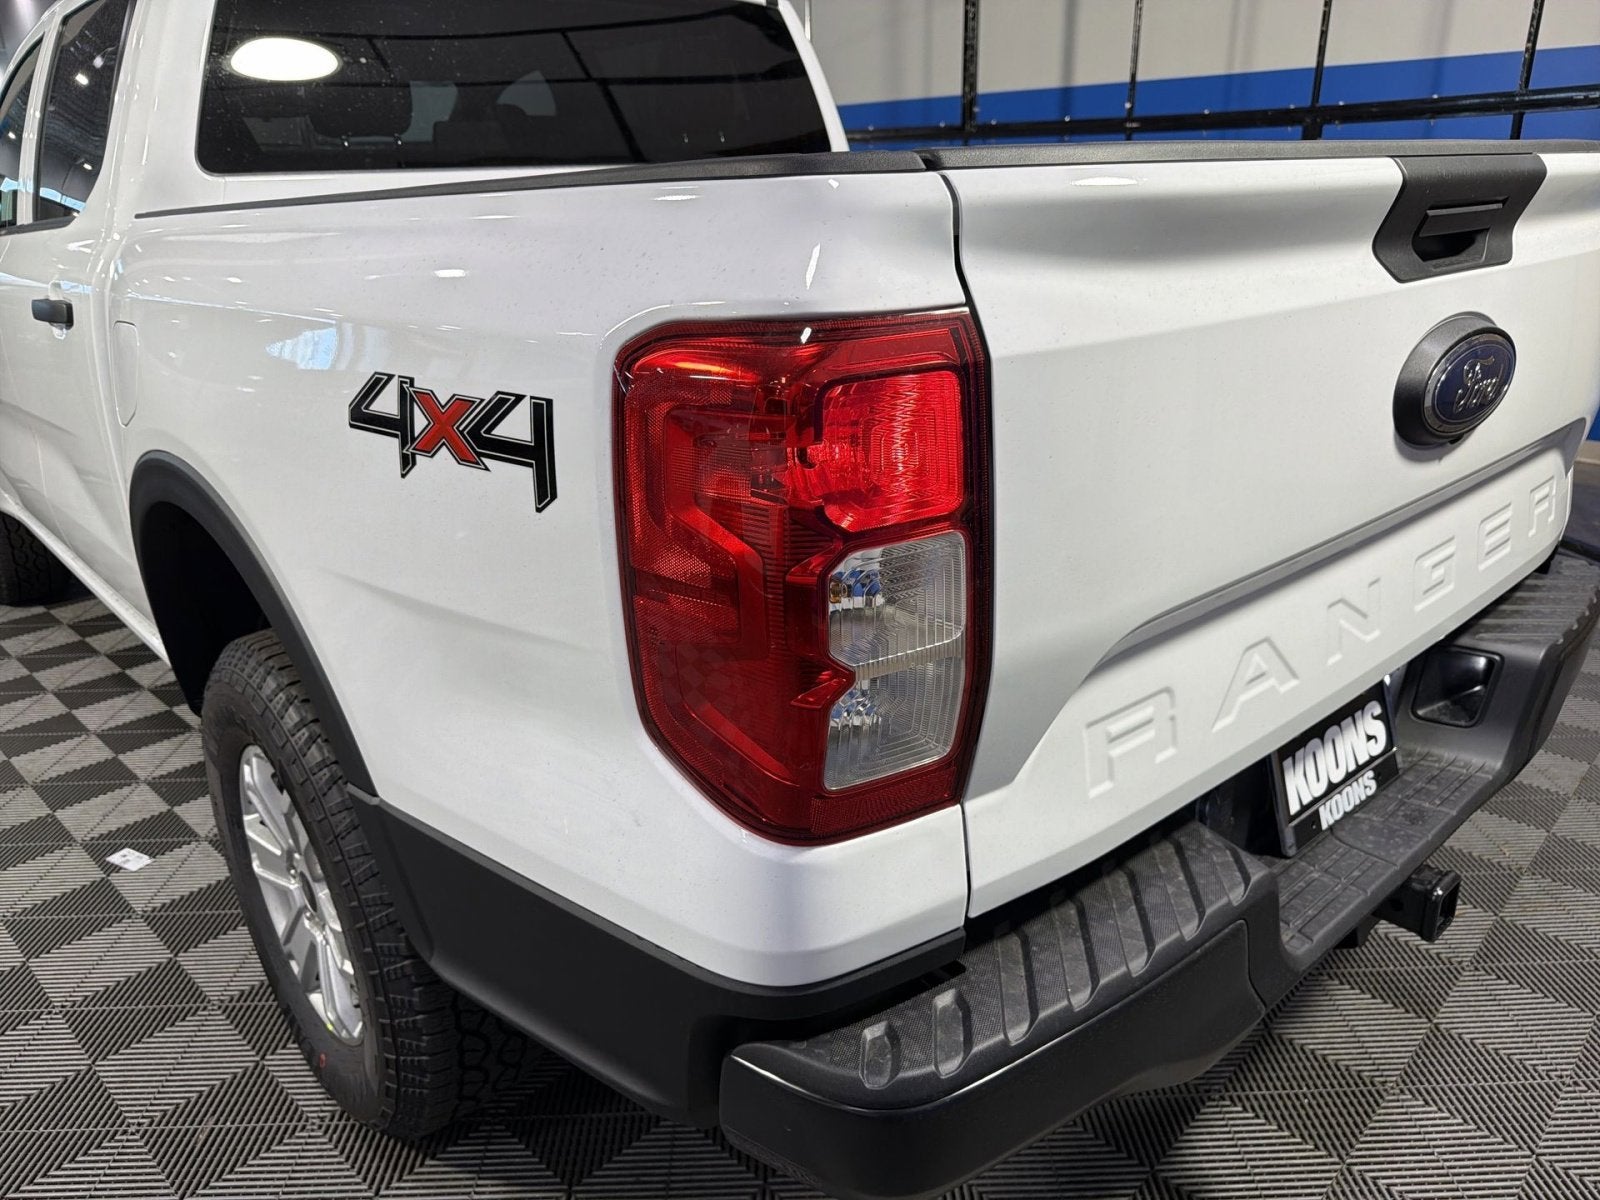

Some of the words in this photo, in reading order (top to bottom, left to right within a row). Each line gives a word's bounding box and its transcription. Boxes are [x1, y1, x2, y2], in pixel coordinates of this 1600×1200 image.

[1452, 356, 1499, 414] Ford
[1083, 475, 1557, 799] RANGER
[1282, 700, 1387, 816] KOONS
[1318, 769, 1378, 831] KOONS
